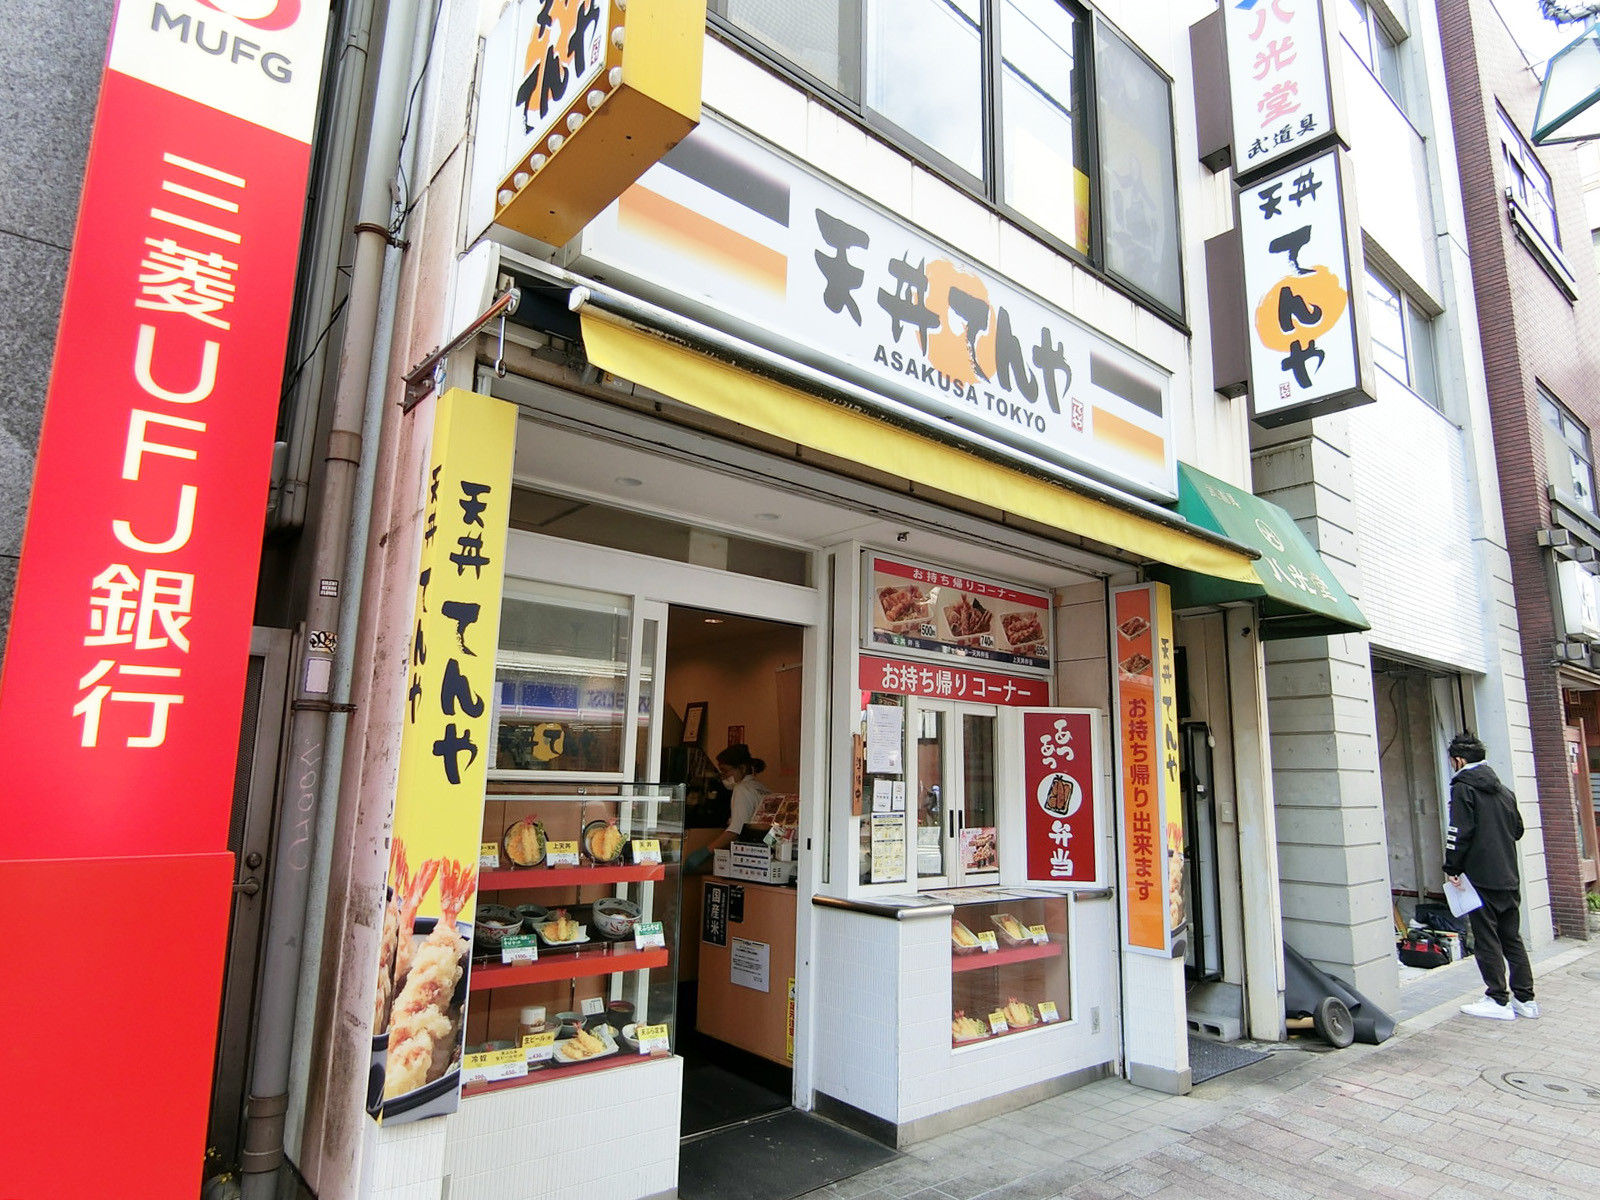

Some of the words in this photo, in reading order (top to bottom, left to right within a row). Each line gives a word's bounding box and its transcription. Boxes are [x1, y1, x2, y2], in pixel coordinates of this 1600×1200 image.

[150, 2, 293, 84] MUFG
[1247, 113, 1319, 159] 武道具
[1257, 166, 1322, 219] 天丼
[1269, 225, 1326, 388] てんや
[873, 344, 980, 406] ASAKUSA
[983, 390, 1047, 434] TOKYO
[72, 152, 246, 748] 三菱UFJ銀行
[913, 568, 1017, 600] お持ち帰りコーナー
[432, 480, 491, 785] 天丼てんや
[881, 663, 1031, 702] お持ち帰りコーナー
[1128, 697, 1154, 901] お持ち帰り出来ます
[1048, 820, 1074, 877] 弁当
